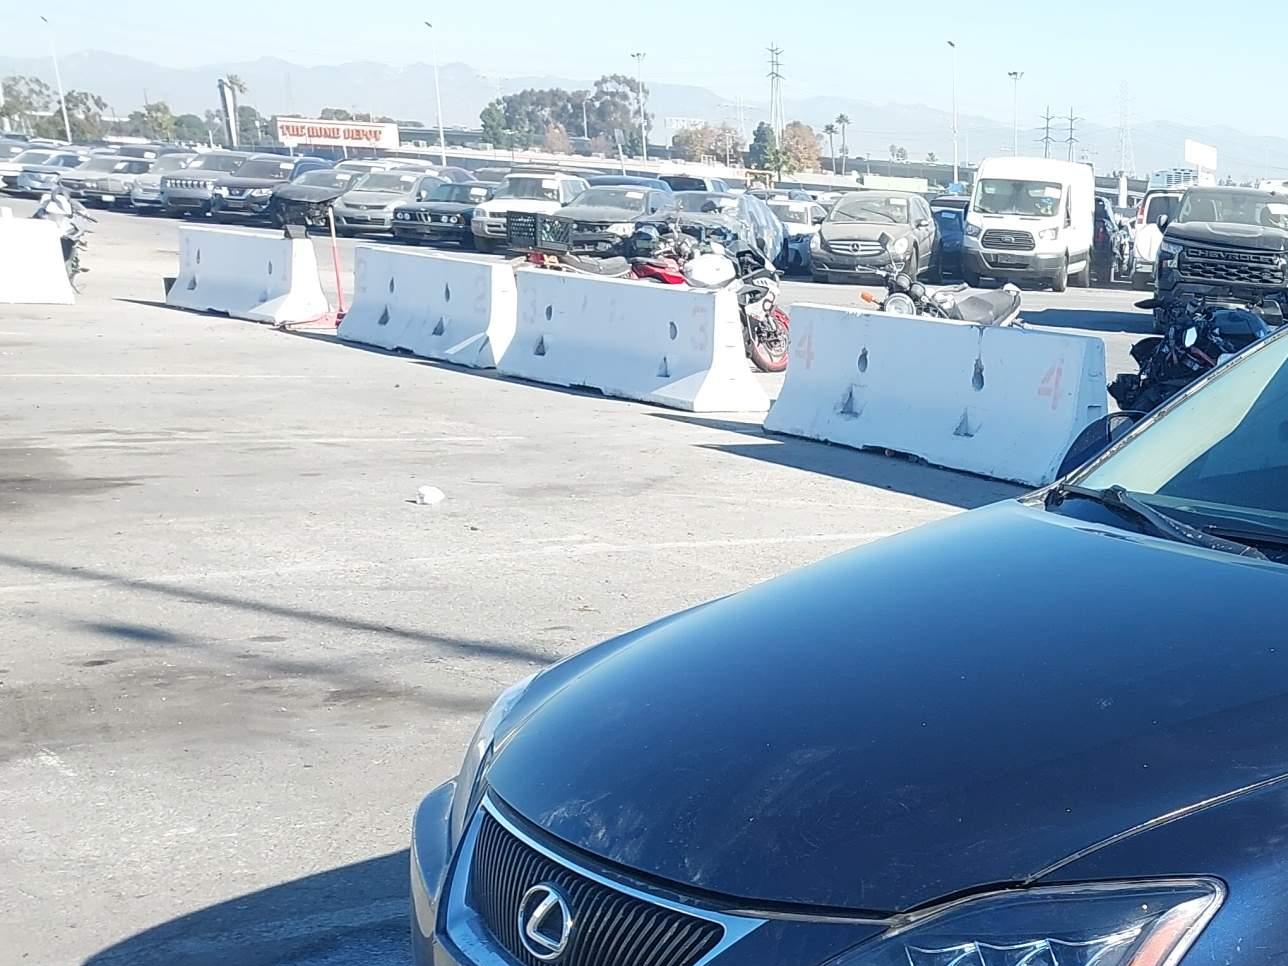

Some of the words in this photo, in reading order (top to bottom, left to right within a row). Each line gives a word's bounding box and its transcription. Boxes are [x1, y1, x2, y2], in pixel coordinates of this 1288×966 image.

[280, 124, 306, 137] THE
[307, 127, 341, 139] HOME
[1037, 360, 1063, 411] 4
